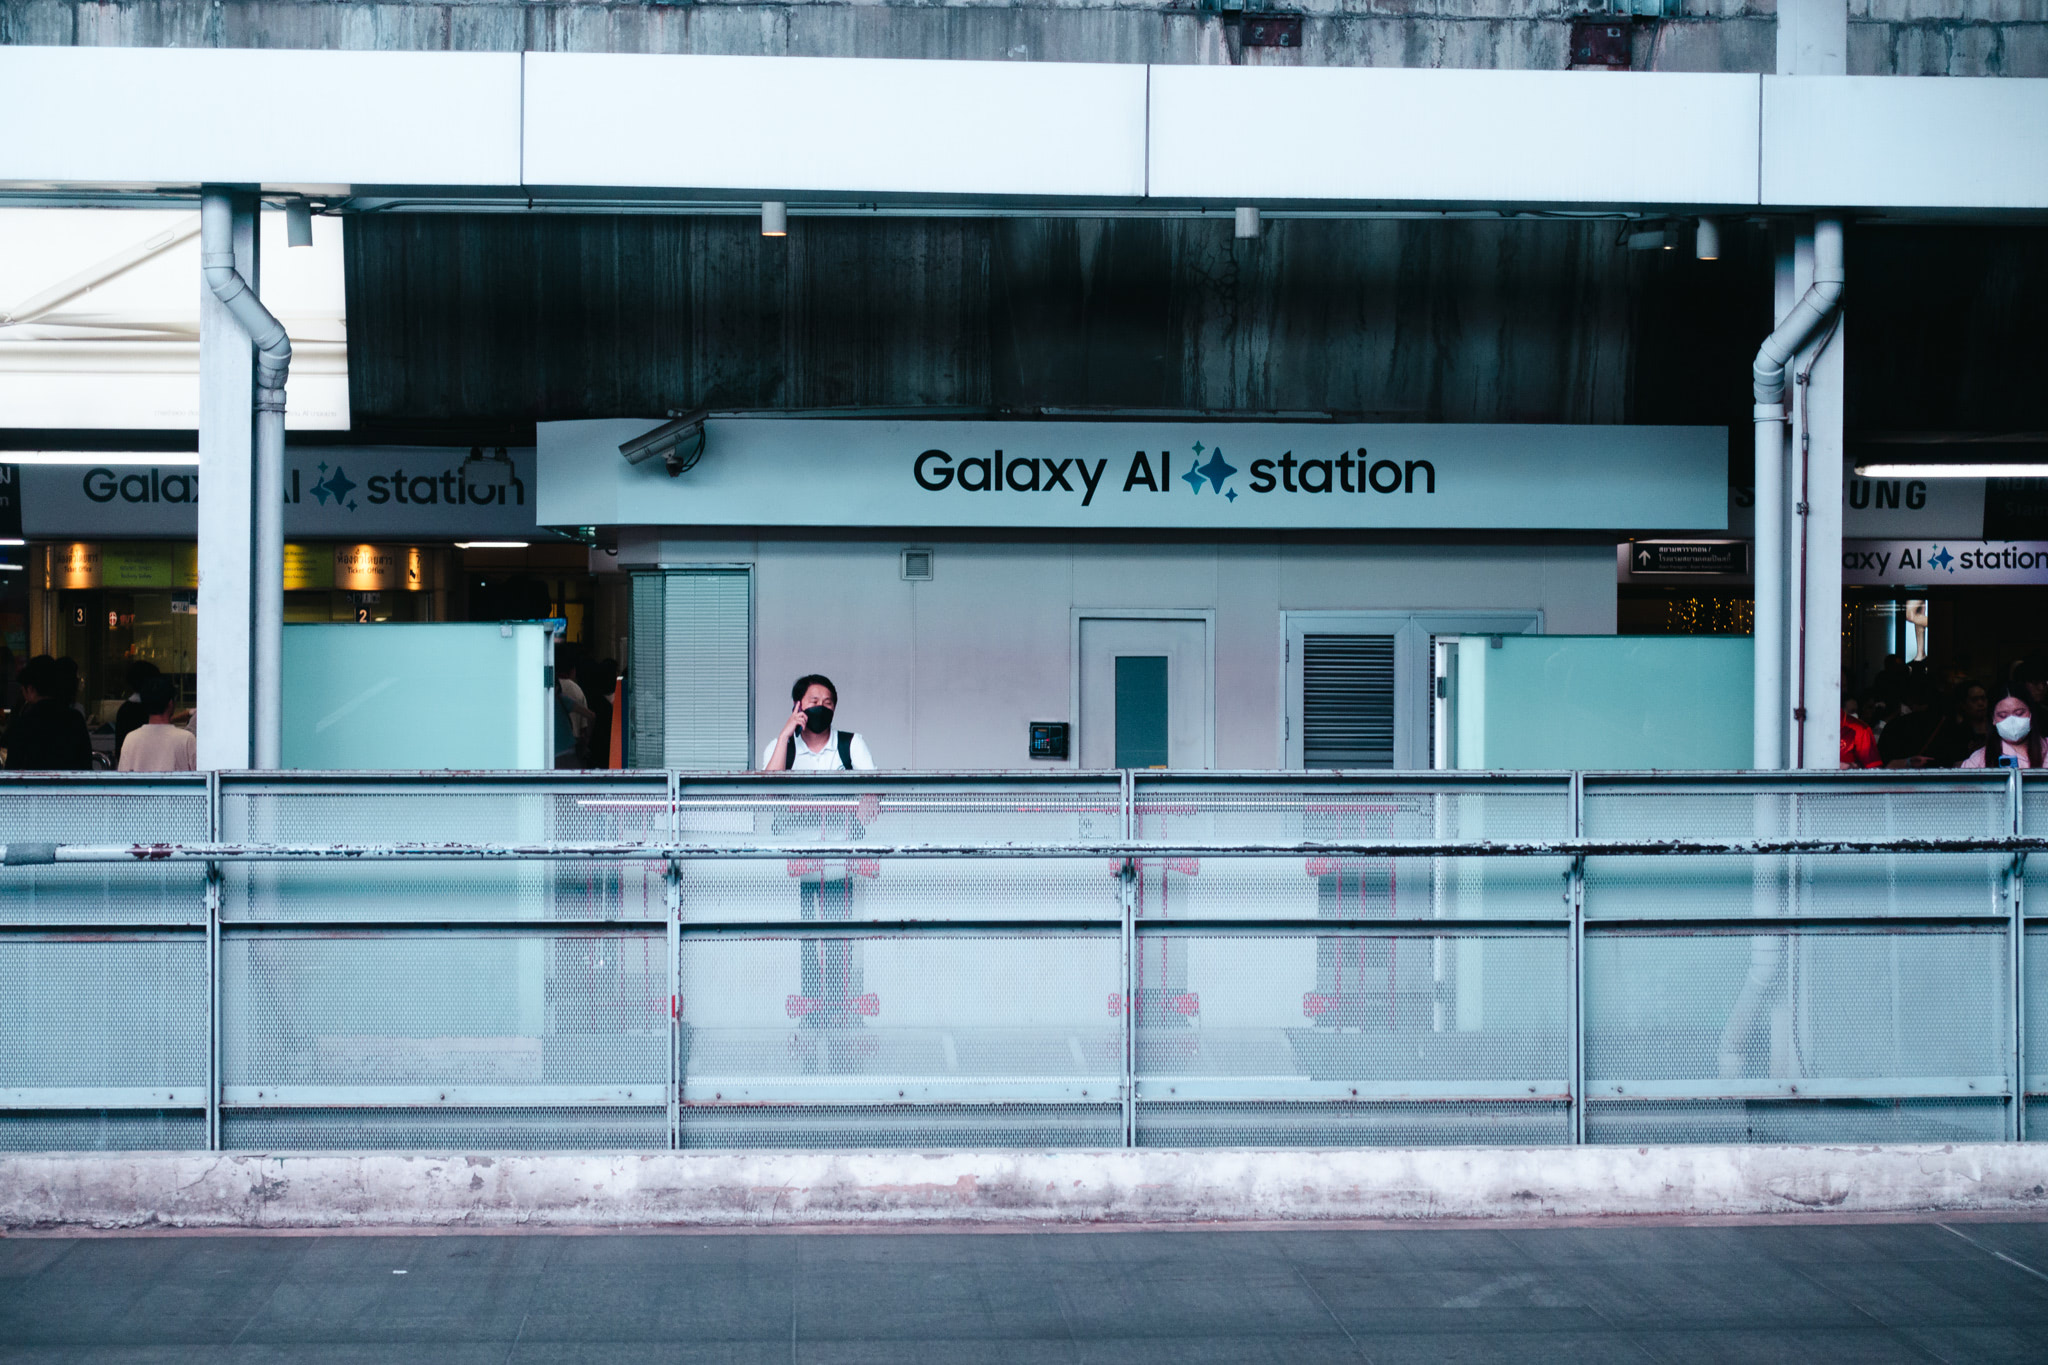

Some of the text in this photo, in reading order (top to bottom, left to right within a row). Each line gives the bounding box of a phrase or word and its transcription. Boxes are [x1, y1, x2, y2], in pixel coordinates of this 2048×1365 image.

[83, 467, 198, 504] Gala
[367, 467, 525, 505] station
[914, 447, 1436, 507] Galaxy AI station
[1842, 546, 2048, 577] axy AI station
[76, 608, 84, 623] 3
[358, 608, 368, 624] 2
